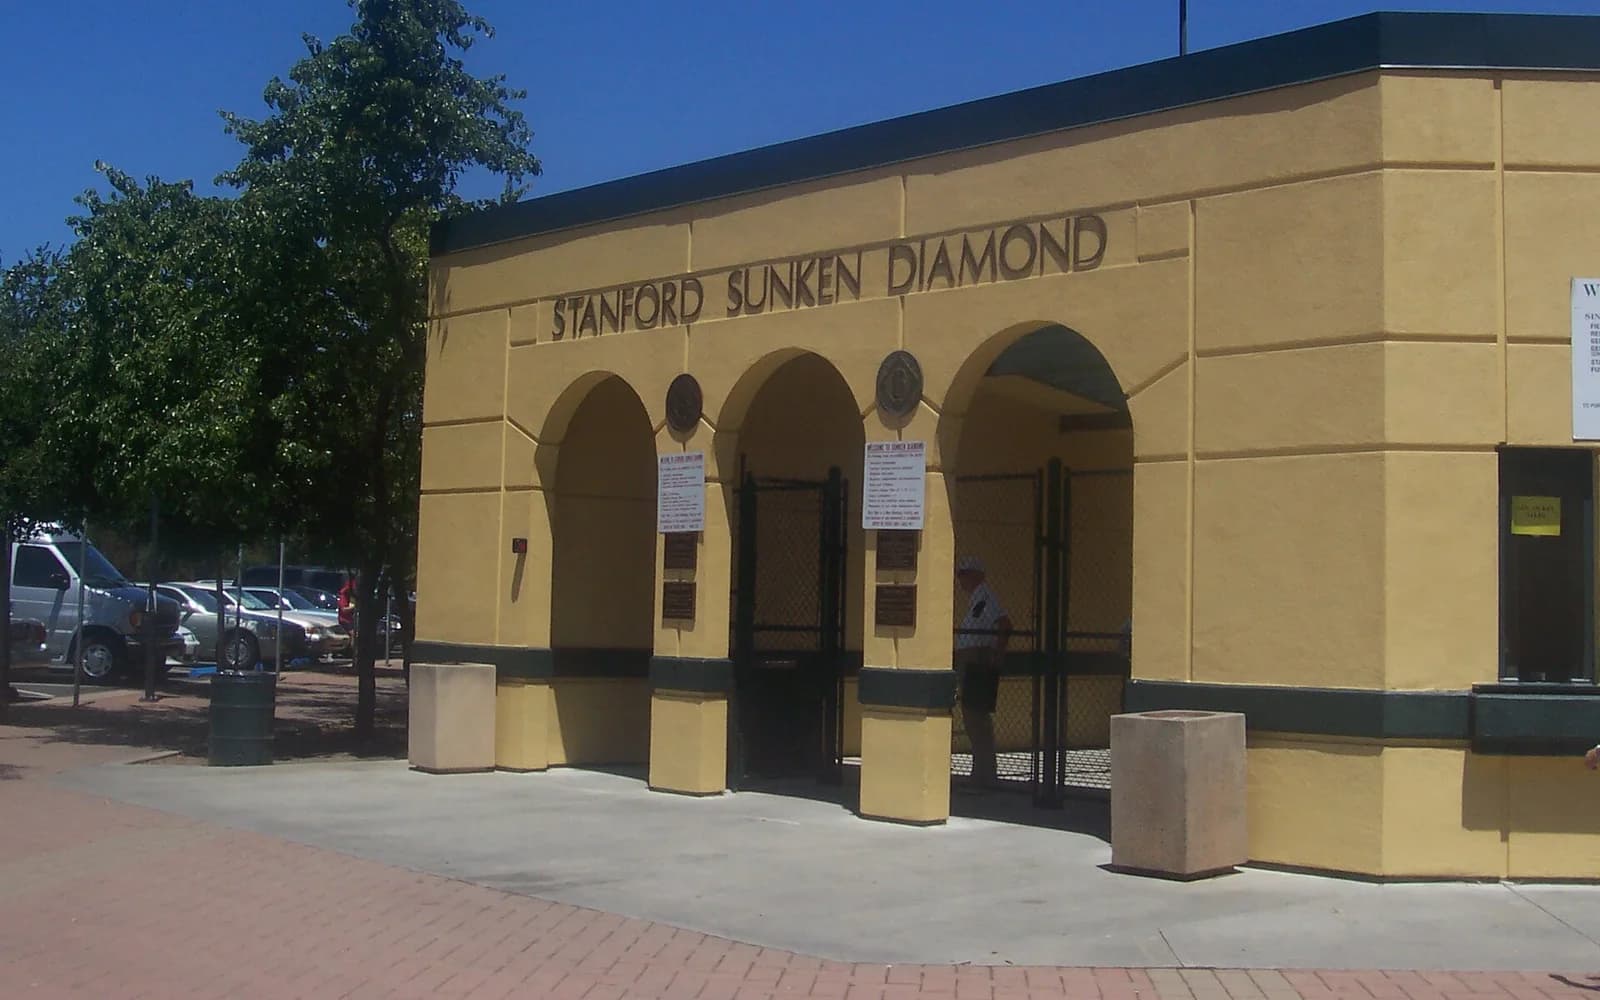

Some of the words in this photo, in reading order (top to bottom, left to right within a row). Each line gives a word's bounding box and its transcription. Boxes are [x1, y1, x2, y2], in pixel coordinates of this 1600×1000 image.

[552, 277, 704, 341] STANFORD
[727, 250, 863, 318] SUNKEN
[887, 214, 1108, 297] DIAMOND
